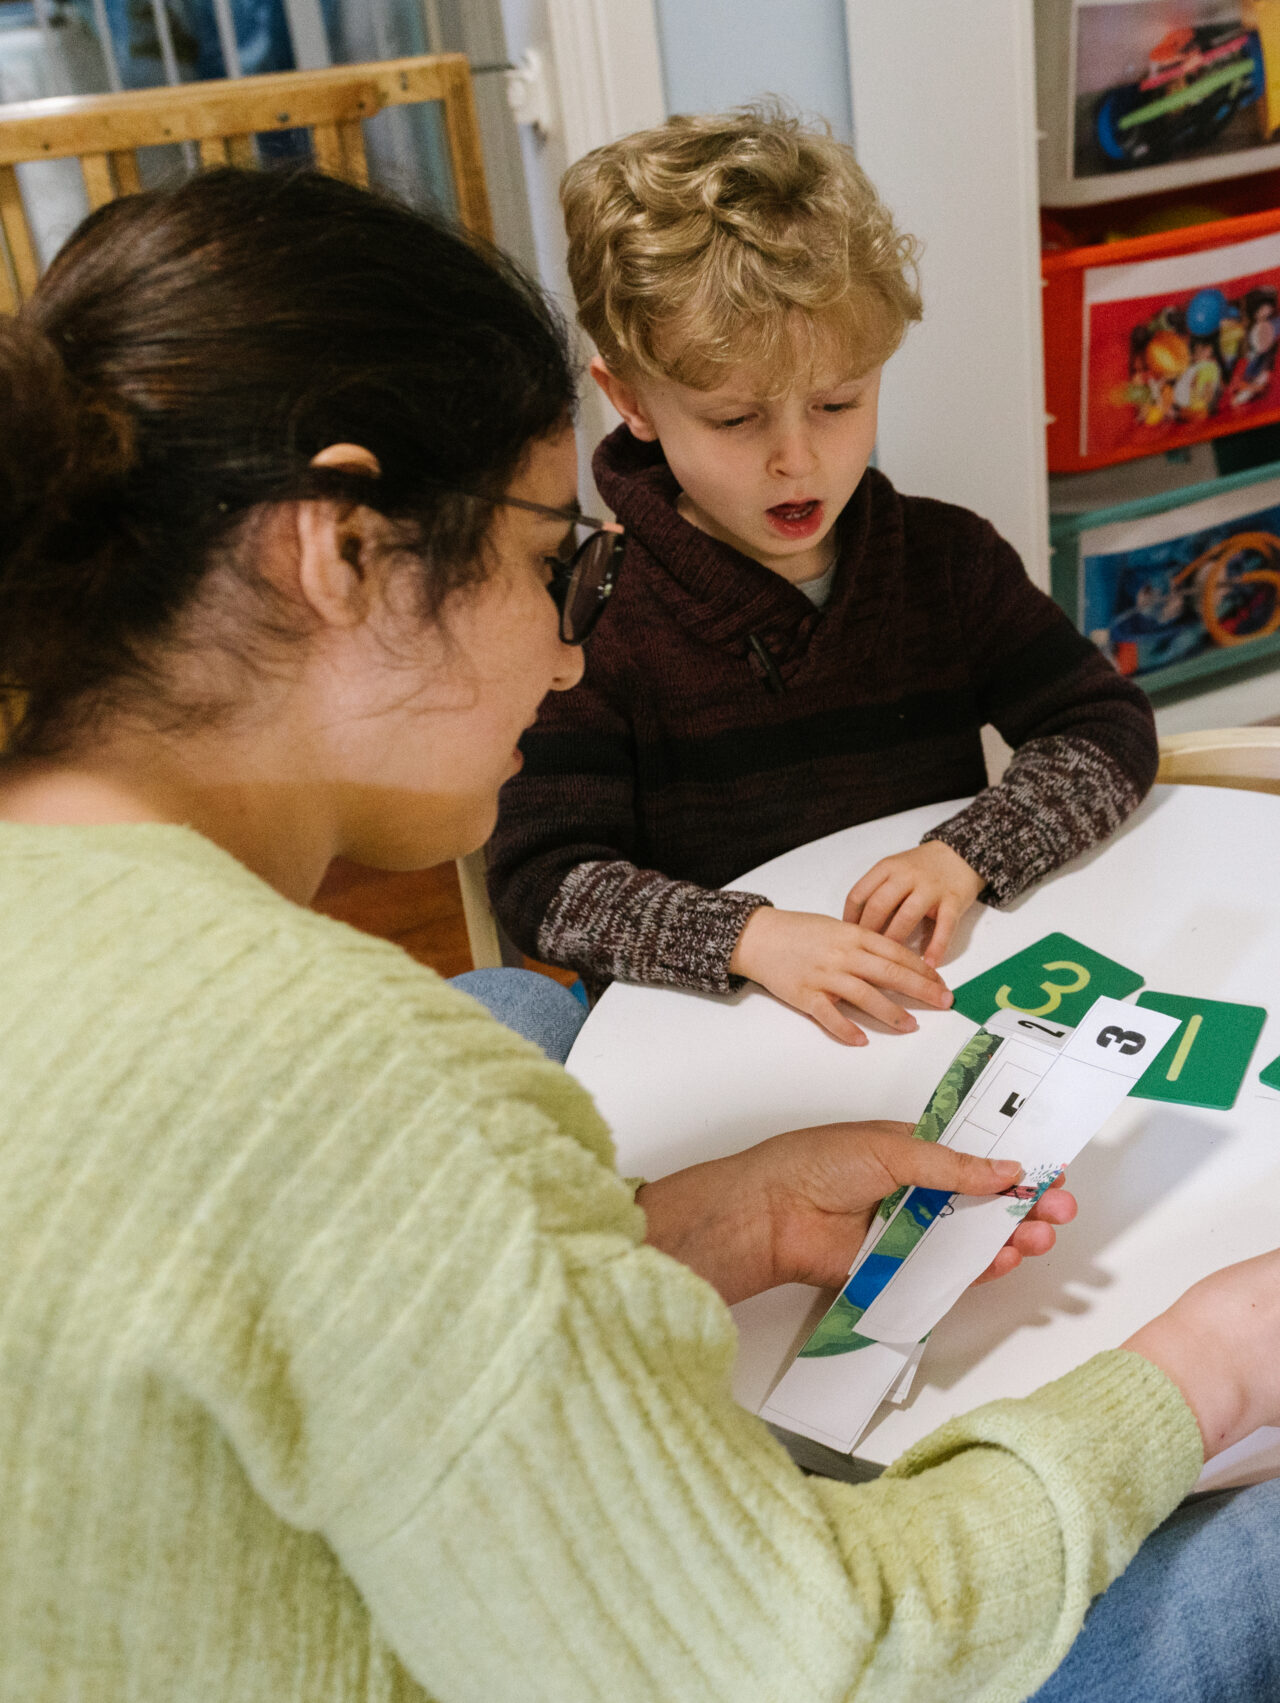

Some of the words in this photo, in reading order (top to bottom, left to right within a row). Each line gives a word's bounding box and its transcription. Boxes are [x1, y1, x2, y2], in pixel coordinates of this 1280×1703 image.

[995, 960, 1091, 1017] 3
[1017, 1020, 1066, 1039] 2
[1096, 1025, 1147, 1056] 3
[1166, 1014, 1203, 1082] 1
